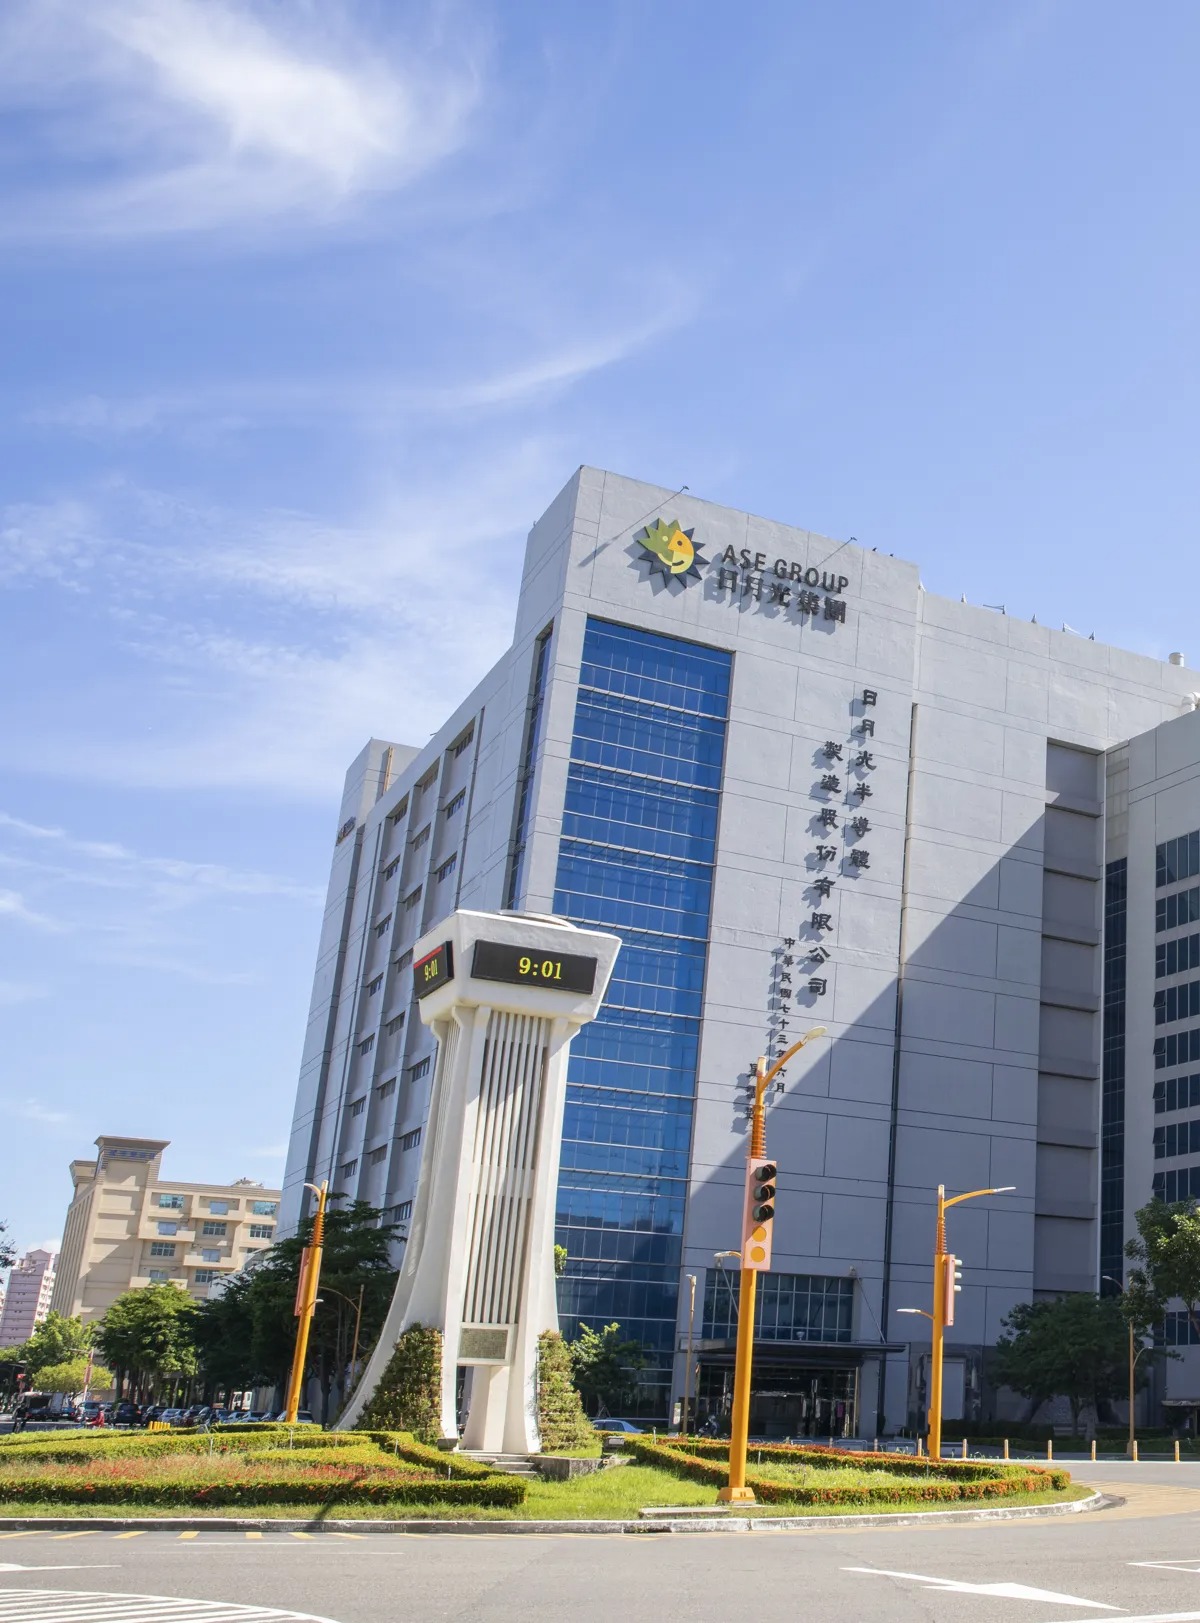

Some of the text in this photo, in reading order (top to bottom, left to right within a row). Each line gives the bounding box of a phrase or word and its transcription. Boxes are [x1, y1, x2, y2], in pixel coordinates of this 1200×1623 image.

[718, 567, 847, 624] 日月光集團
[722, 544, 849, 594] ASE GROUP
[848, 689, 877, 869] 日月光半導體
[807, 741, 843, 996] 製造股份有限公司
[424, 959, 438, 982] 9:01
[518, 957, 562, 980] 9:01
